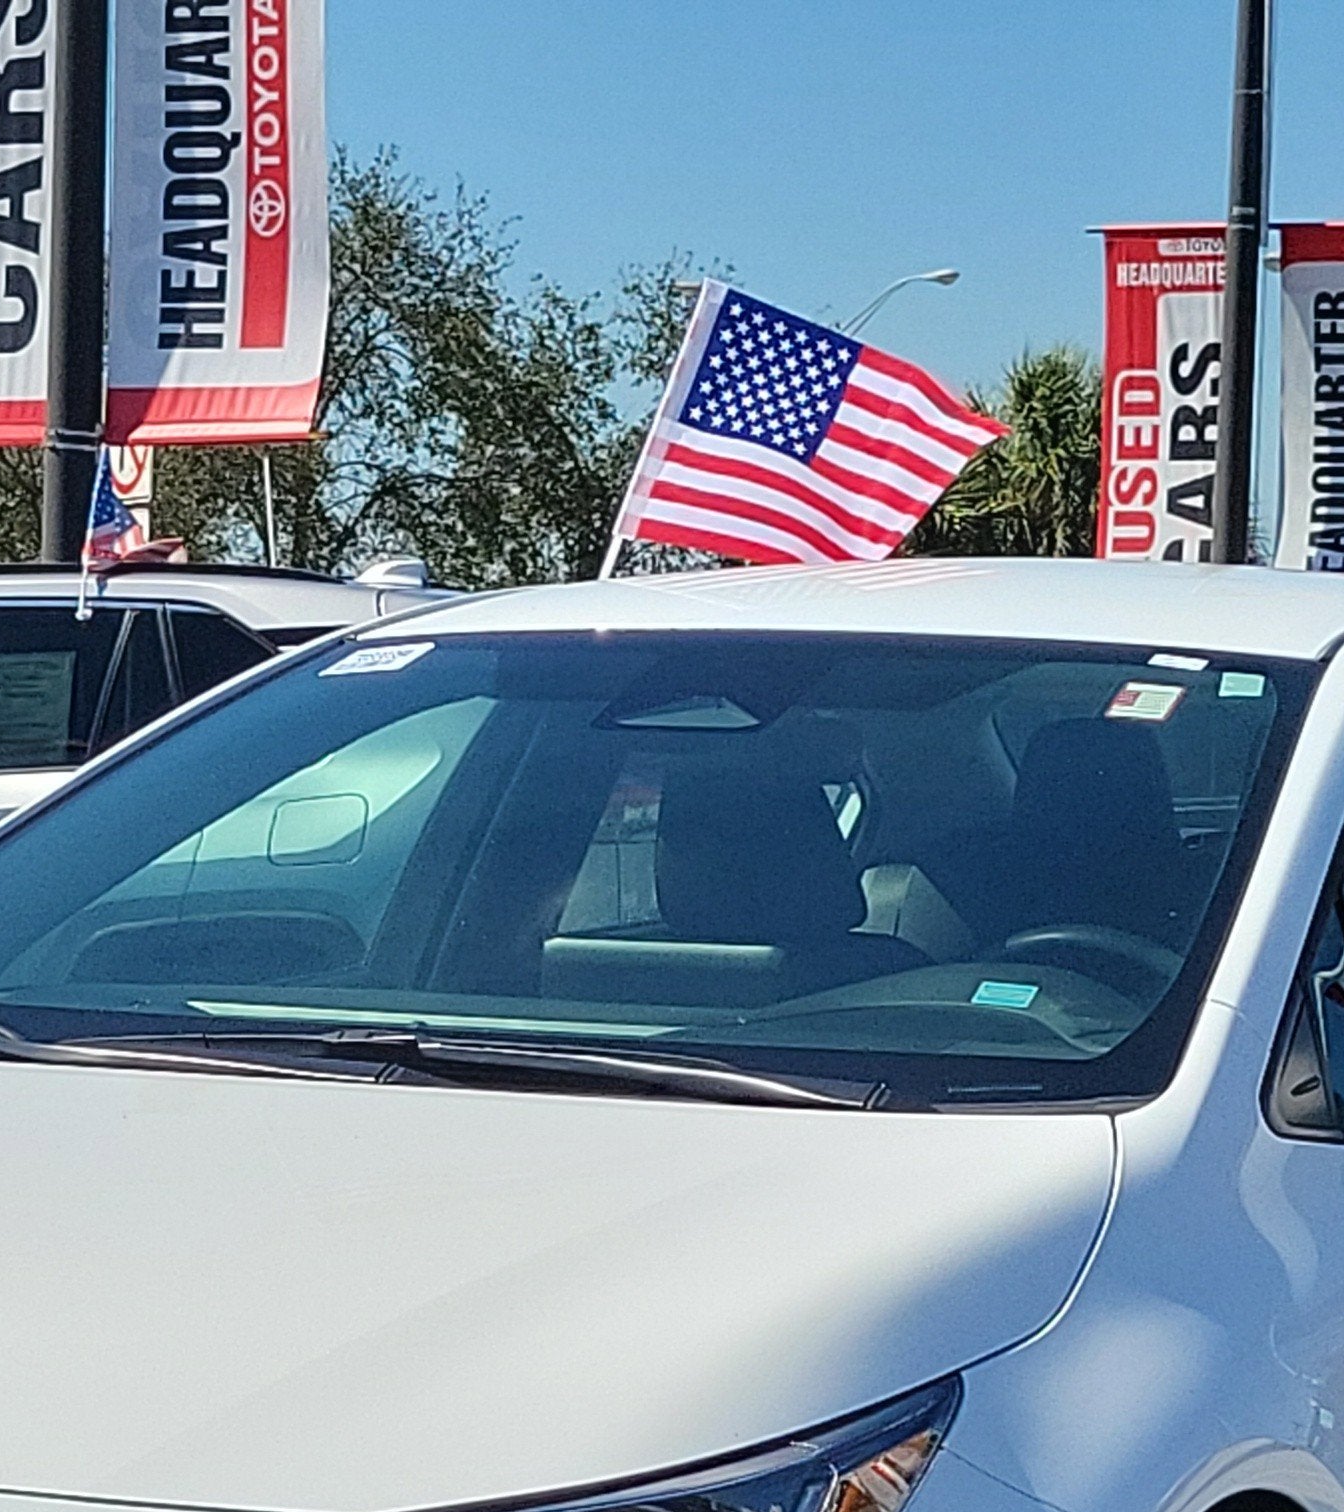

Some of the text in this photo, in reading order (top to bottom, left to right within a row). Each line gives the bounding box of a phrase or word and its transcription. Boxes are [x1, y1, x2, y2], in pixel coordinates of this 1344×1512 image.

[253, 0, 280, 173] TOYOTA
[1117, 262, 1226, 289] HEADQUARTE
[1186, 239, 1223, 251] TOYO
[1111, 373, 1161, 553] USED
